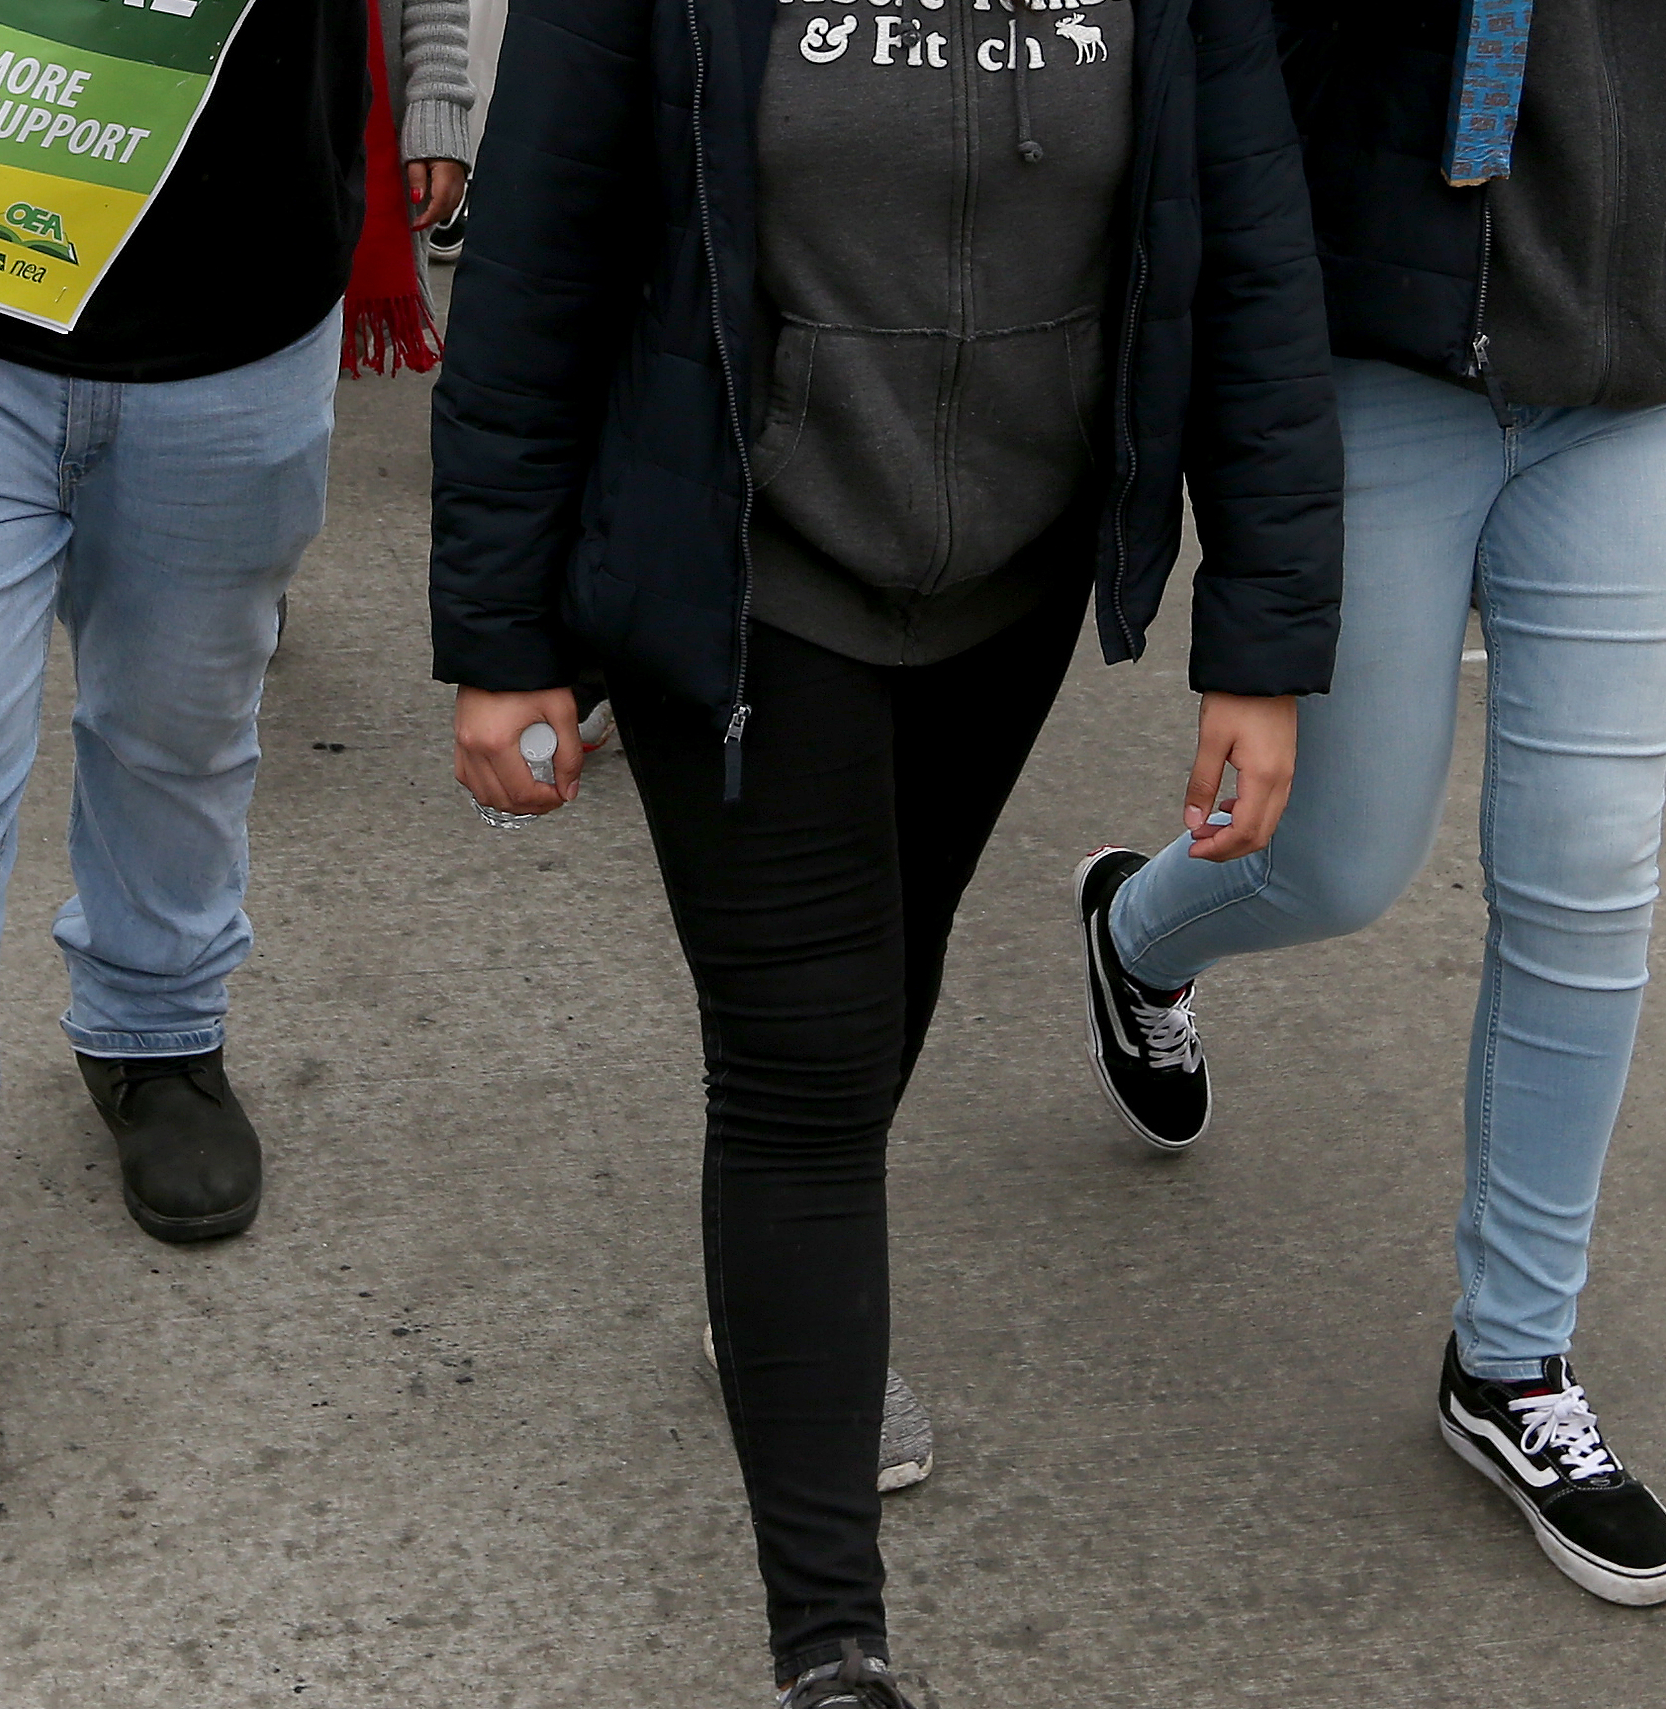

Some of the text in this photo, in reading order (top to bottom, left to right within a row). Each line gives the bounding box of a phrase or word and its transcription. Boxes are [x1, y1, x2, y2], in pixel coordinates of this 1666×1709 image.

[798, 14, 859, 64] &
[4, 201, 64, 242] OEA
[9, 258, 47, 284] nea
